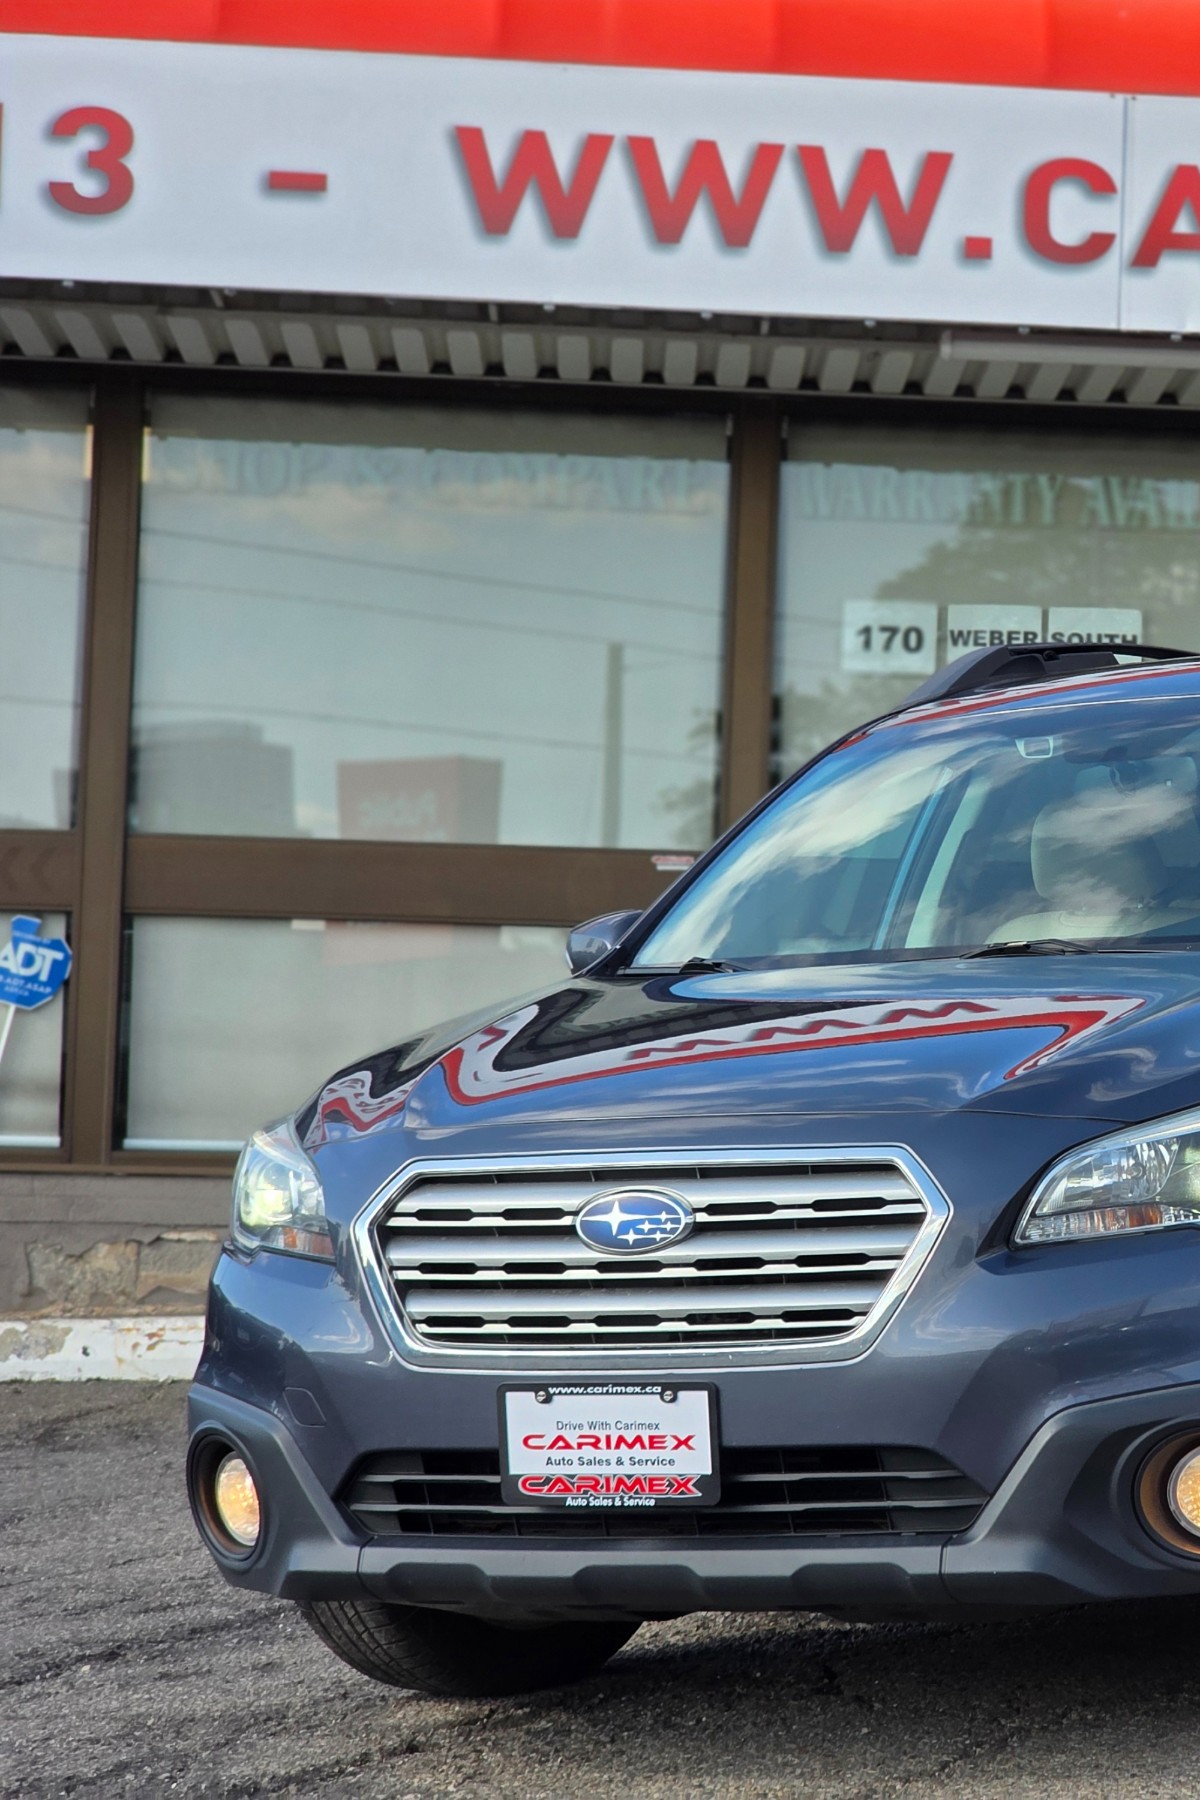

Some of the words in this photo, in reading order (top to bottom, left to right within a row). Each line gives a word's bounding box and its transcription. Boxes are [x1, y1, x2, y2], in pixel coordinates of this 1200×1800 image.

[855, 625, 924, 654] 170
[949, 629, 1039, 648] WEBER
[1051, 632, 1138, 646] SOUTH
[0, 941, 65, 982] ADT
[548, 1383, 662, 1395] www.carimex.ca
[556, 1420, 584, 1431] Drive
[587, 1420, 611, 1431] With
[615, 1420, 661, 1431] Carimex
[521, 1433, 697, 1451] CARIMEX
[545, 1456, 574, 1467] Auto
[578, 1456, 612, 1467] Sales
[615, 1456, 625, 1467] &
[629, 1456, 676, 1467] Service
[518, 1474, 702, 1497] CARIMEX
[565, 1496, 587, 1507] Auto
[589, 1496, 613, 1507] Sales
[614, 1497, 622, 1507] &
[623, 1496, 656, 1507] Service
